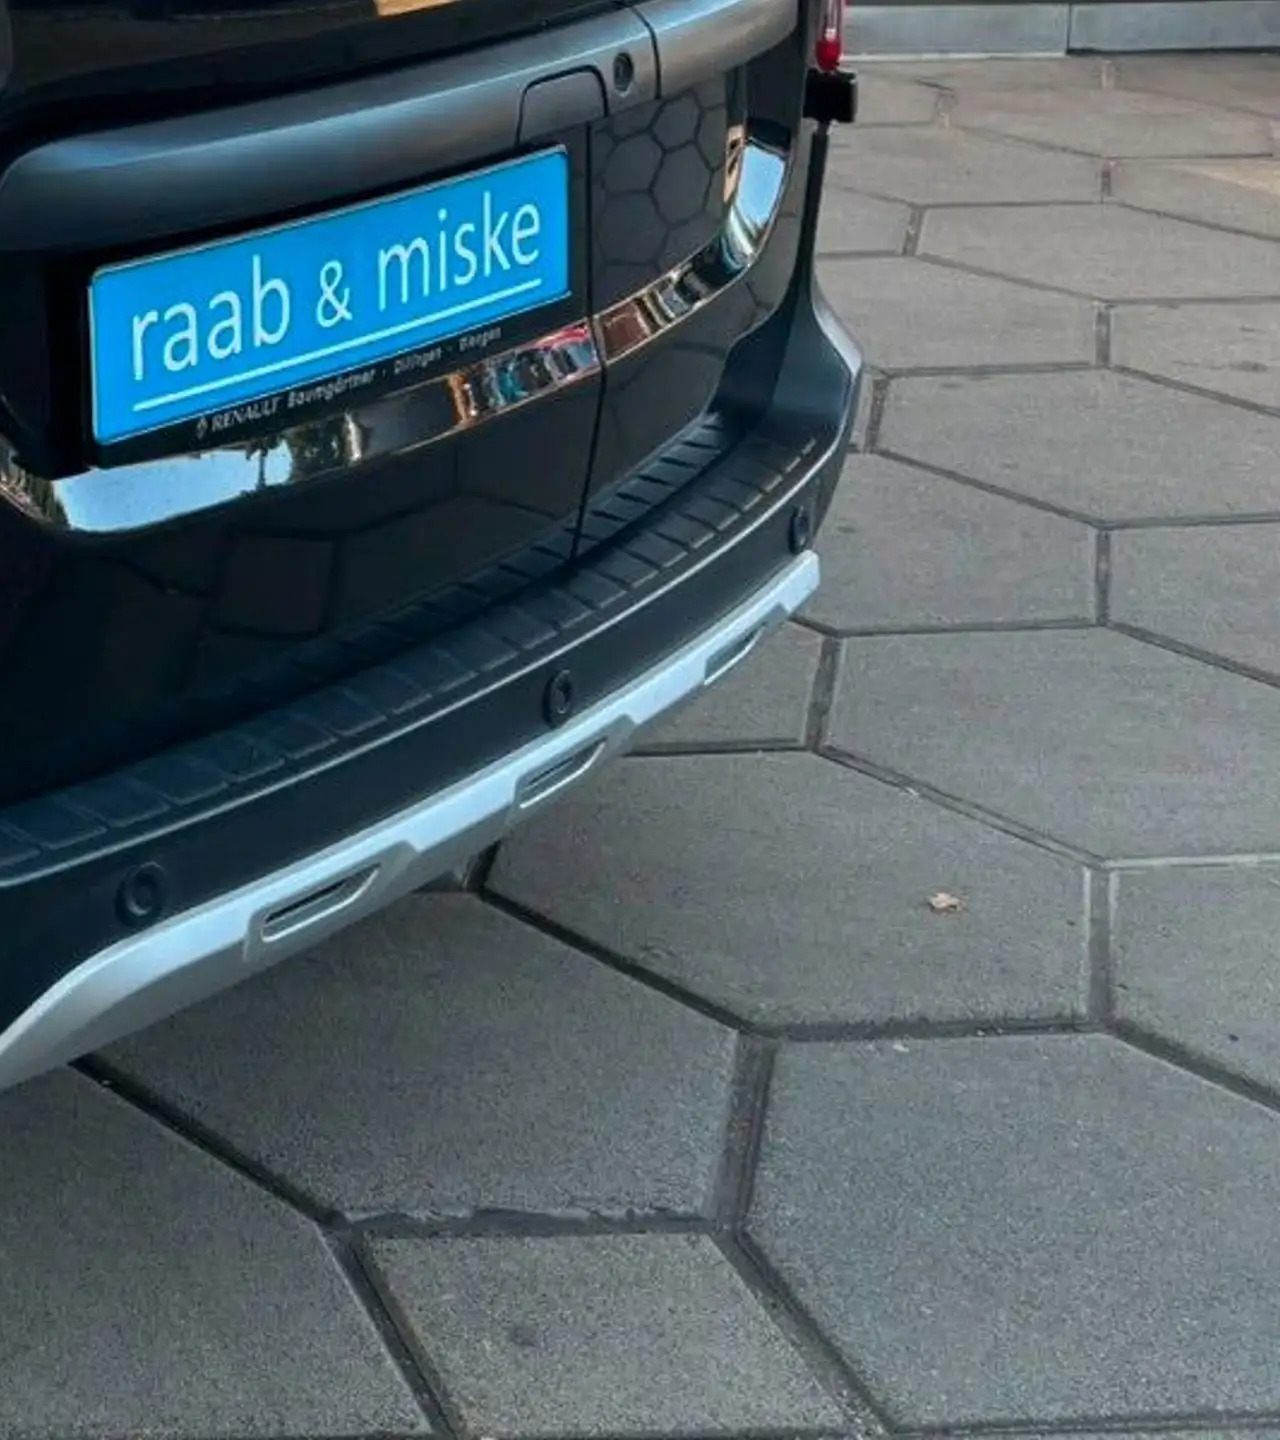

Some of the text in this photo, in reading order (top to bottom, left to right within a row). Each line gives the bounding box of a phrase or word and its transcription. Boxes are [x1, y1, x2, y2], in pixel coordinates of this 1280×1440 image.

[131, 190, 541, 381] raab & miske
[211, 396, 283, 432] RENAULT
